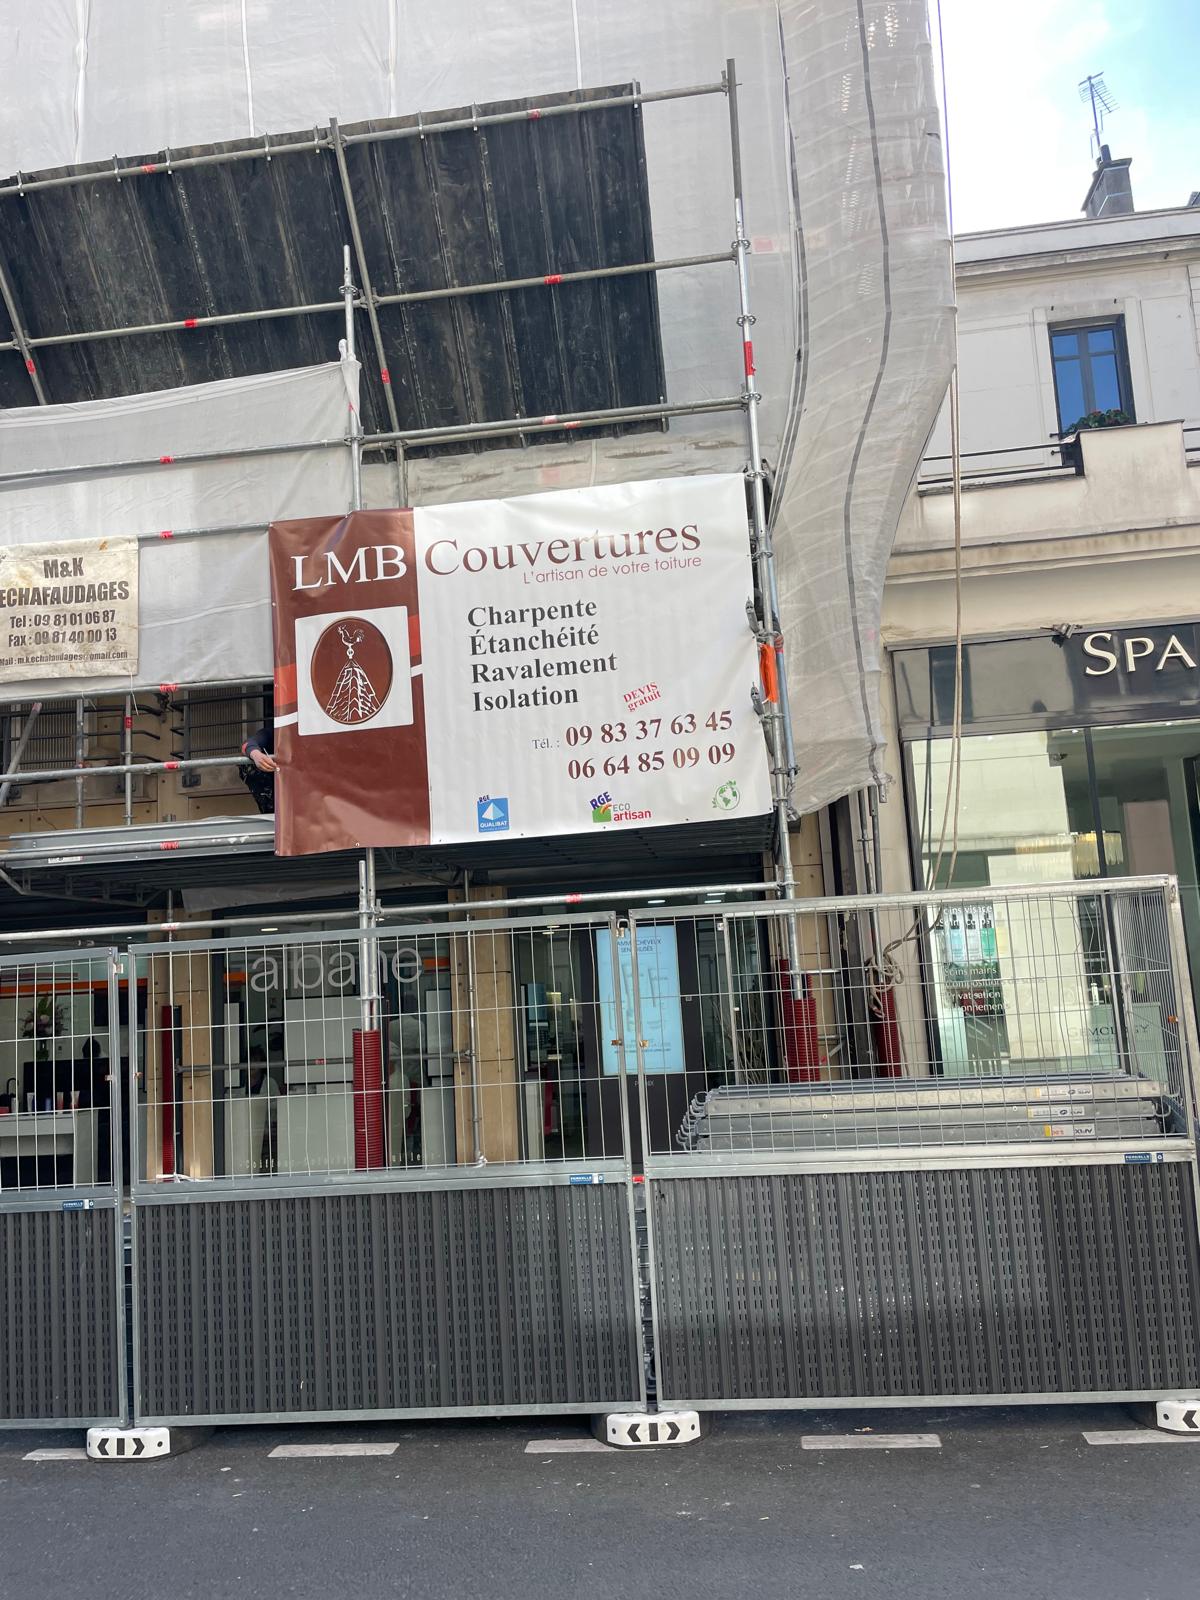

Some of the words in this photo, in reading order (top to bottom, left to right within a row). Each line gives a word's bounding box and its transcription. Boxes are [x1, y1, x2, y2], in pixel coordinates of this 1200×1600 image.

[43, 557, 85, 579] M&K
[290, 544, 407, 591] LMB
[425, 524, 701, 576] Couvertures
[523, 568, 584, 585] L'artisan
[588, 565, 608, 579] de
[612, 561, 650, 576] votre
[655, 555, 702, 572] toiture
[0, 580, 130, 609] ECHAFAUDAGES
[34, 614, 51, 627] 09
[53, 613, 67, 627] 81
[69, 612, 83, 626] 01
[85, 610, 100, 625] 06
[102, 609, 116, 624] 87
[467, 600, 598, 628] Charpente
[34, 631, 50, 646] 09
[69, 630, 85, 644] 40
[87, 629, 103, 644] 00
[105, 627, 118, 642] 13
[468, 624, 600, 657] Étanchéité
[1083, 632, 1198, 676] SPA
[471, 652, 619, 684] Ravalement
[473, 685, 579, 712] Isolation
[623, 681, 658, 703] DEVIS
[627, 689, 662, 712] gratuit
[565, 725, 593, 747] 09
[600, 722, 628, 744] 83
[635, 718, 662, 740] 37
[670, 713, 697, 735] 63
[705, 710, 733, 732] 45
[567, 757, 596, 780] 06
[603, 754, 630, 777] 64
[638, 750, 665, 773] 85
[672, 747, 700, 769] 09
[708, 742, 736, 765] 09
[478, 794, 490, 803] RGE
[590, 791, 613, 811] RGE
[612, 803, 631, 812] ECO
[613, 809, 652, 822] artisan
